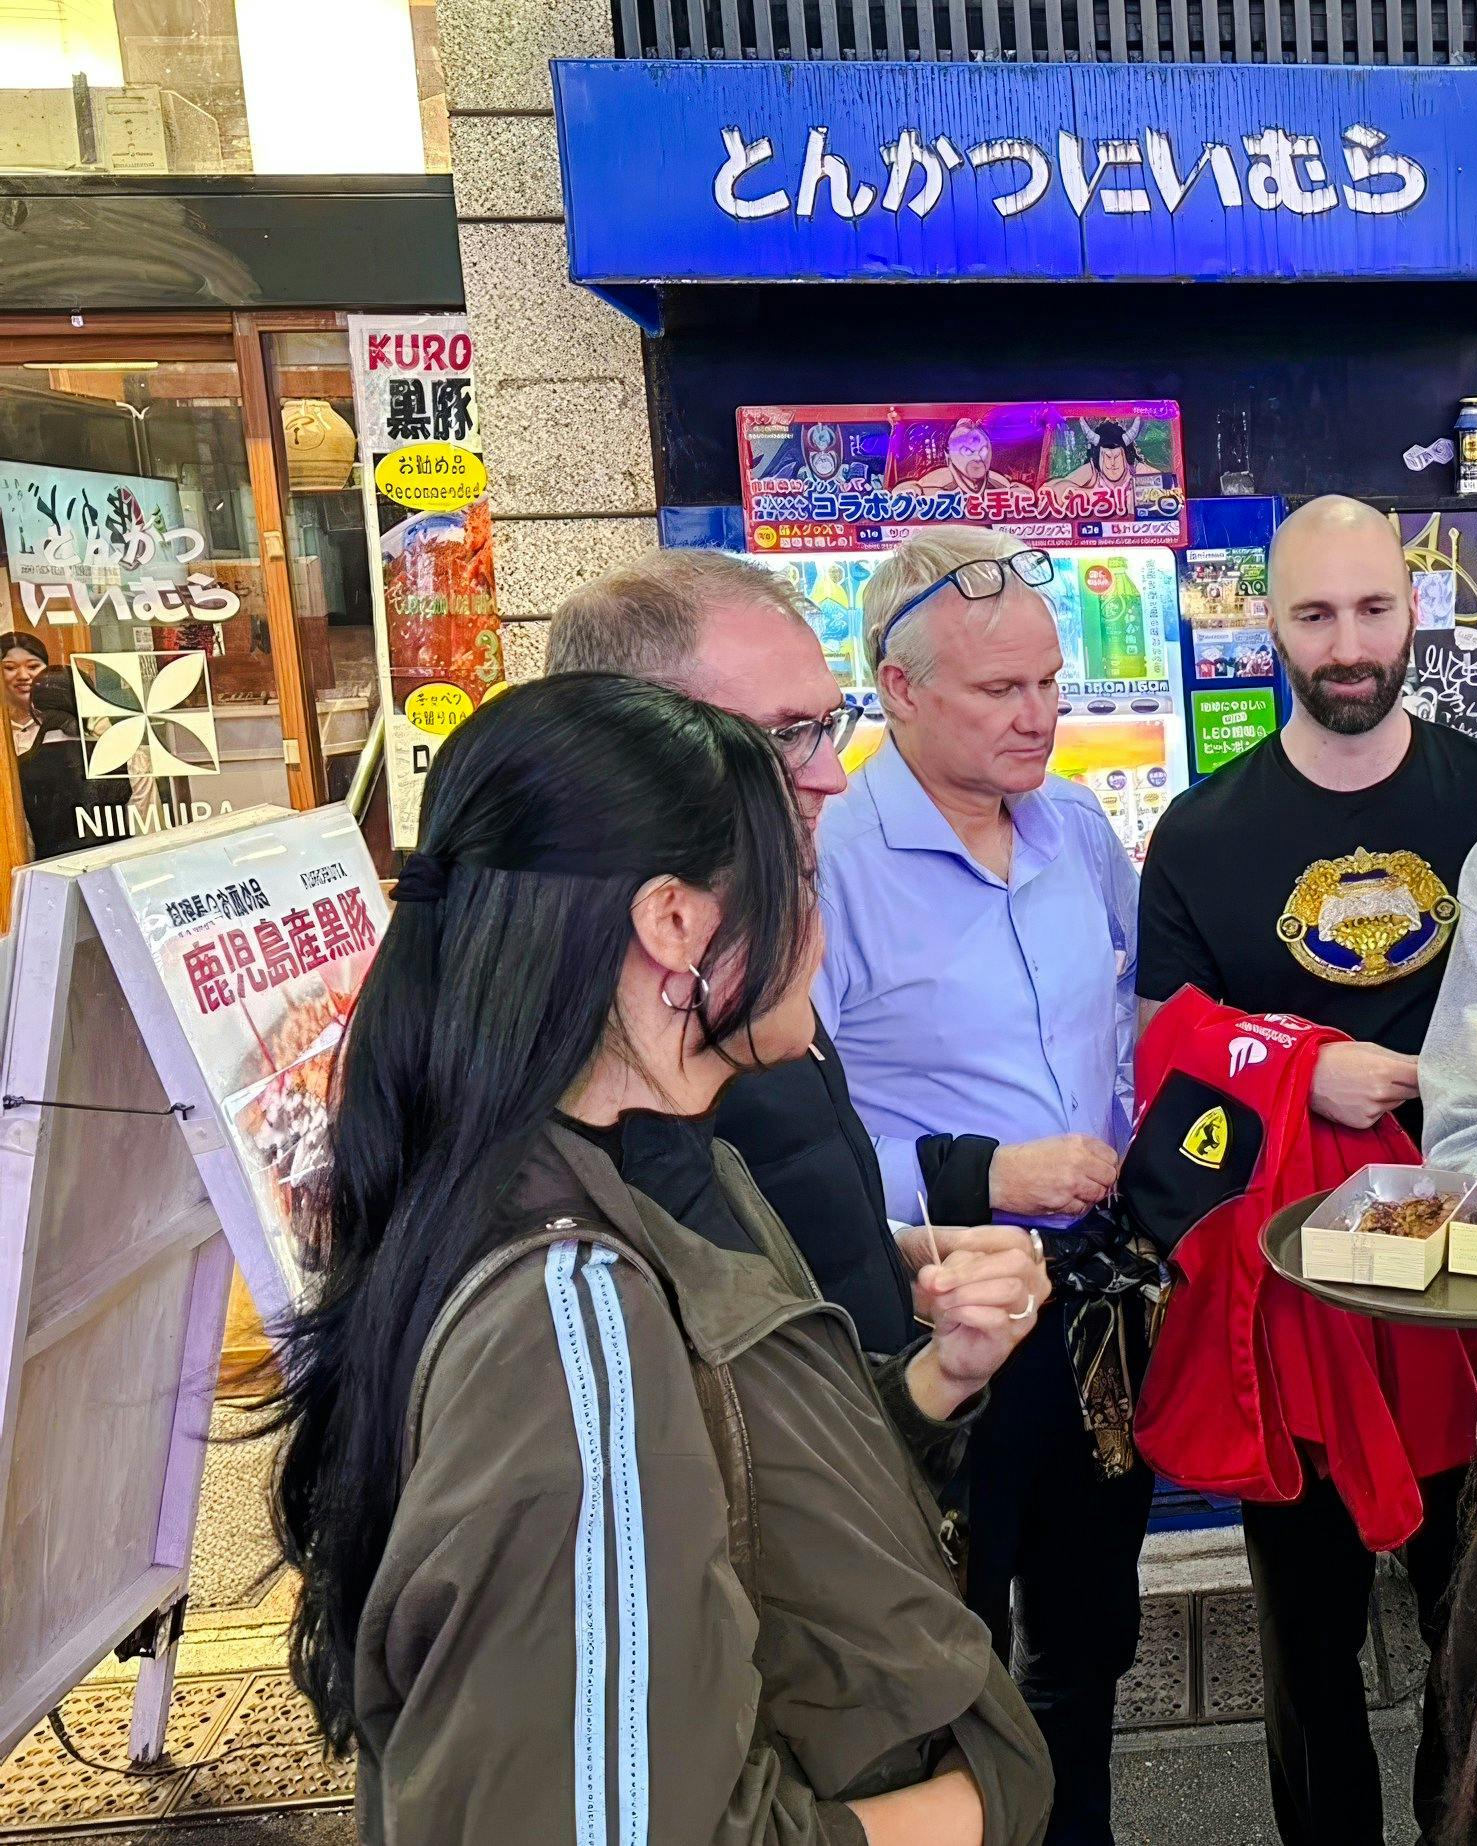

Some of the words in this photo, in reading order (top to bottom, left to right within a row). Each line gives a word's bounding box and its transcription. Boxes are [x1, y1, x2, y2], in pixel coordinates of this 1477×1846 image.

[713, 123, 1426, 220] とんかつにいむら
[368, 333, 473, 372] KURO
[386, 377, 474, 442] 黒豚
[43, 526, 205, 567] とんかつ
[19, 573, 241, 628] にいむら
[182, 886, 377, 1015] 鹿児島産黒豚
